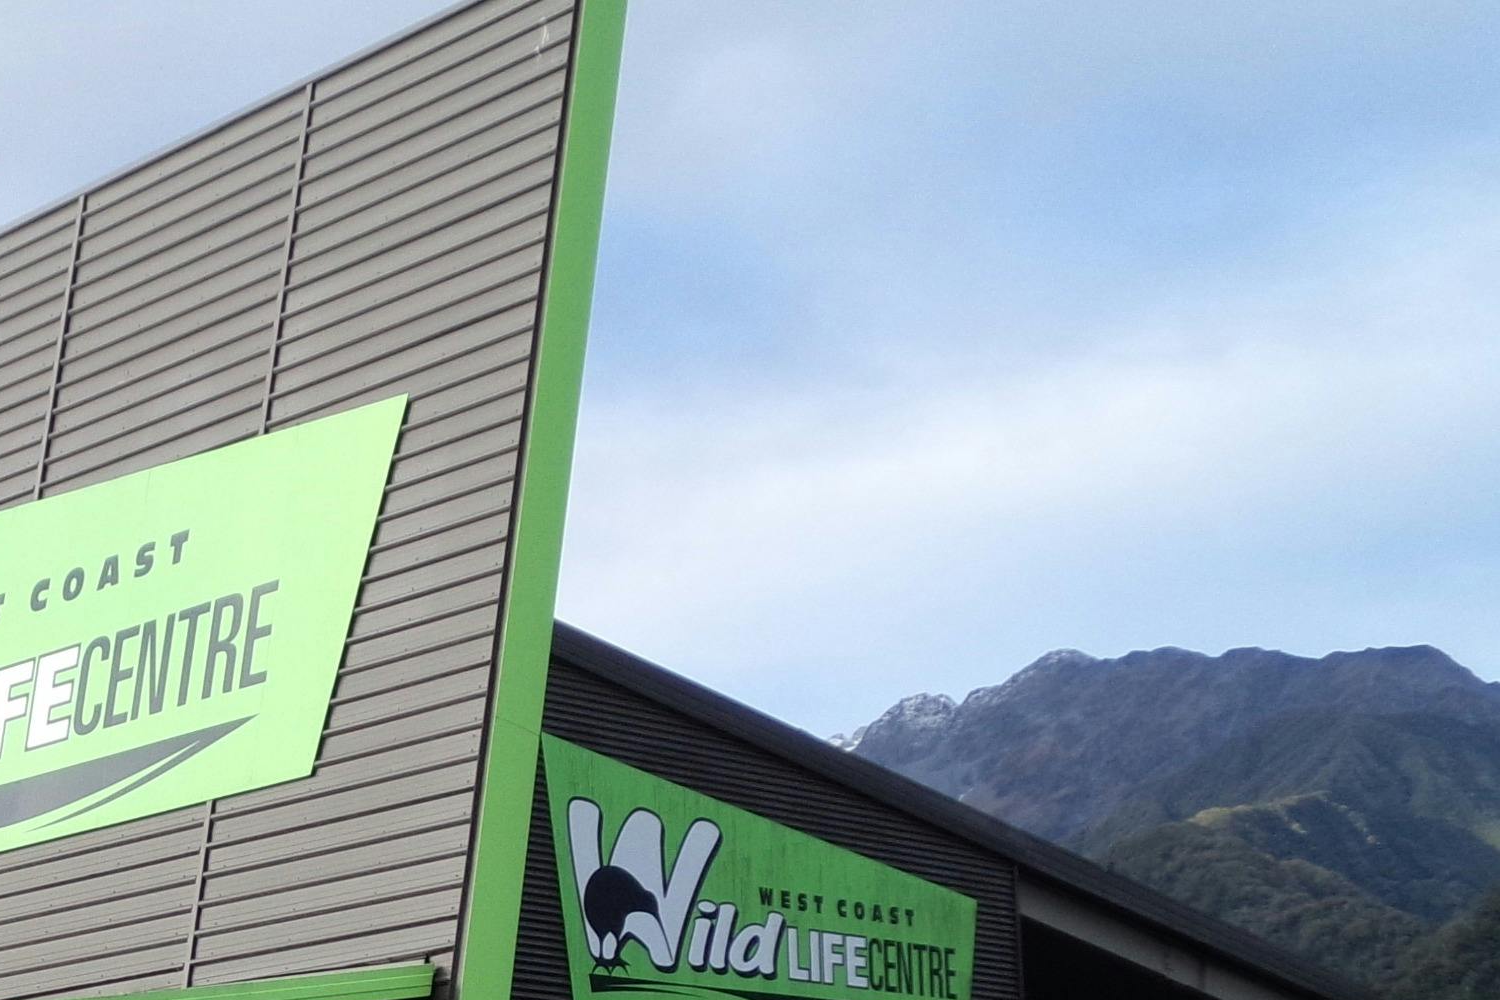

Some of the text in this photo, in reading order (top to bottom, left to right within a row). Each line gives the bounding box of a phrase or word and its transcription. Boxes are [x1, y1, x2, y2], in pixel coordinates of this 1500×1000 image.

[30, 529, 191, 612] COAST
[758, 887, 915, 927] WEST COAST
